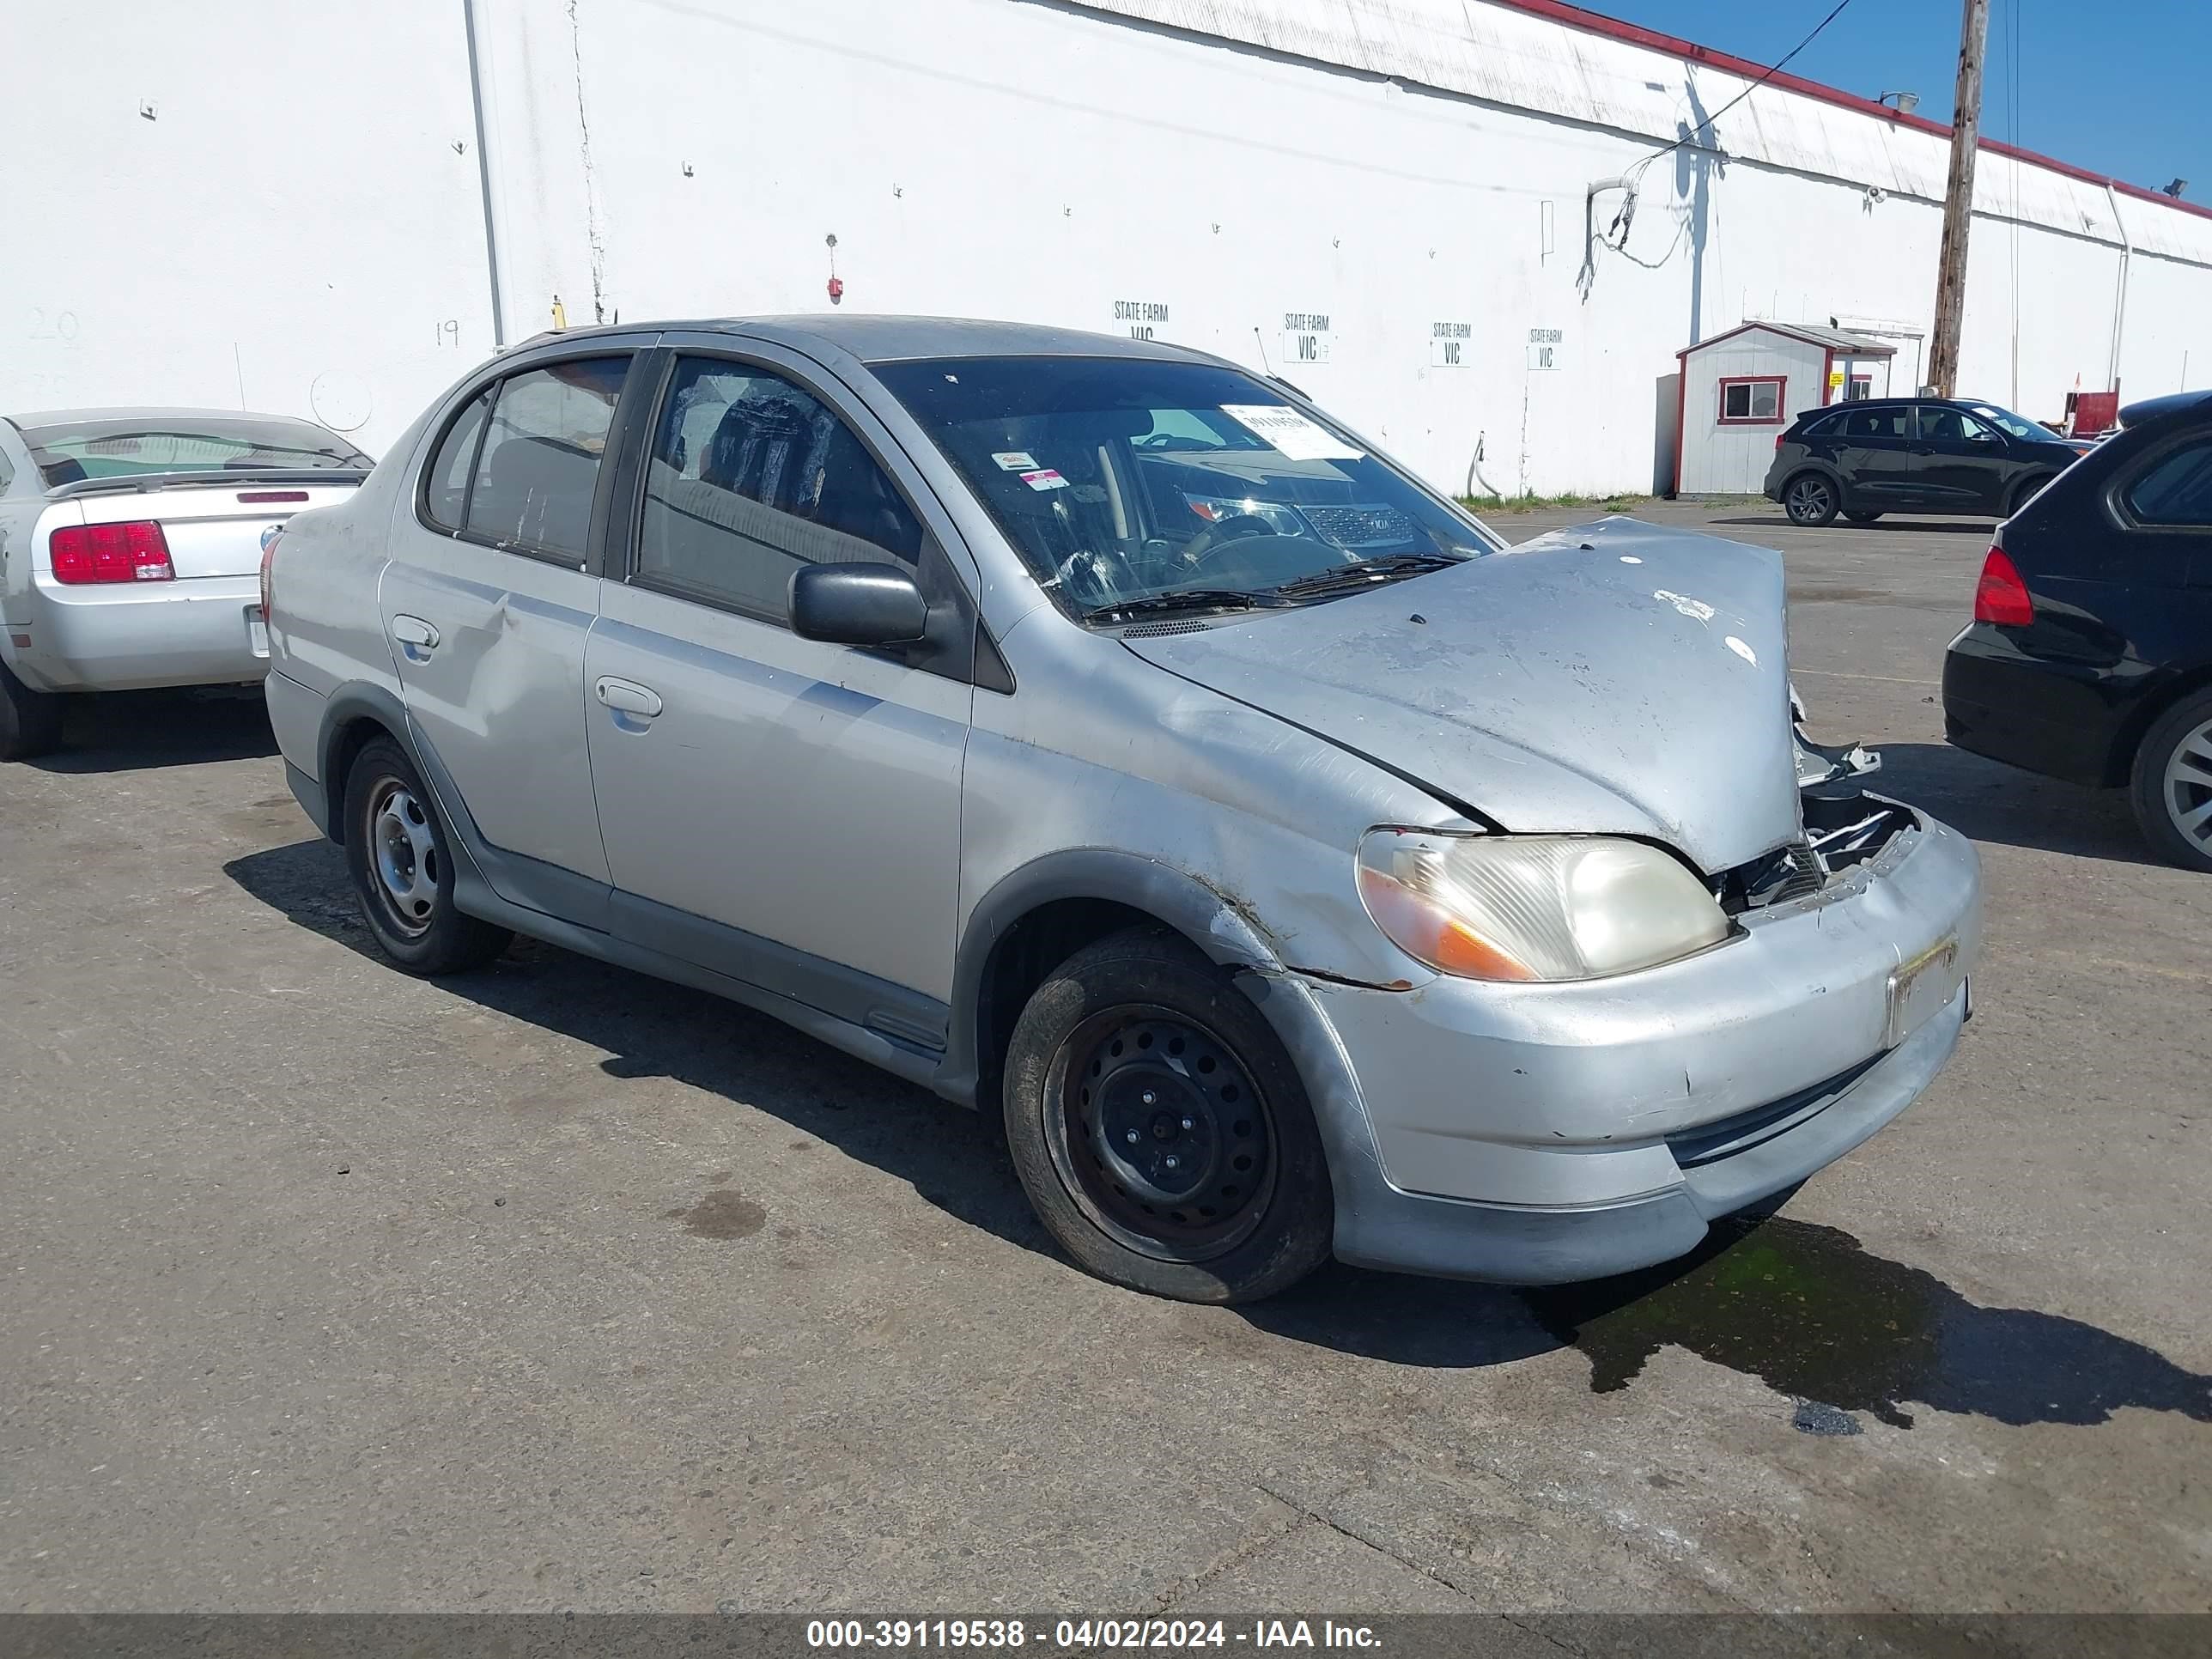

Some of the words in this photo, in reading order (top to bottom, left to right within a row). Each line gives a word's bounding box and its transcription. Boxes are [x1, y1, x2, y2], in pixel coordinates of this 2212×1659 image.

[1115, 301, 1140, 320] STATE
[1142, 302, 1169, 323] FARM
[1285, 313, 1306, 331] STATE
[1308, 314, 1329, 331] FARM
[437, 319, 459, 349] 19
[1433, 322, 1452, 337] STATE
[1453, 323, 1471, 339] FARM
[1530, 328, 1546, 343] STATE
[1546, 329, 1563, 343] FARM
[1297, 335, 1316, 361] VIC
[1444, 342, 1460, 364] VIC
[1539, 347, 1553, 368] VIC
